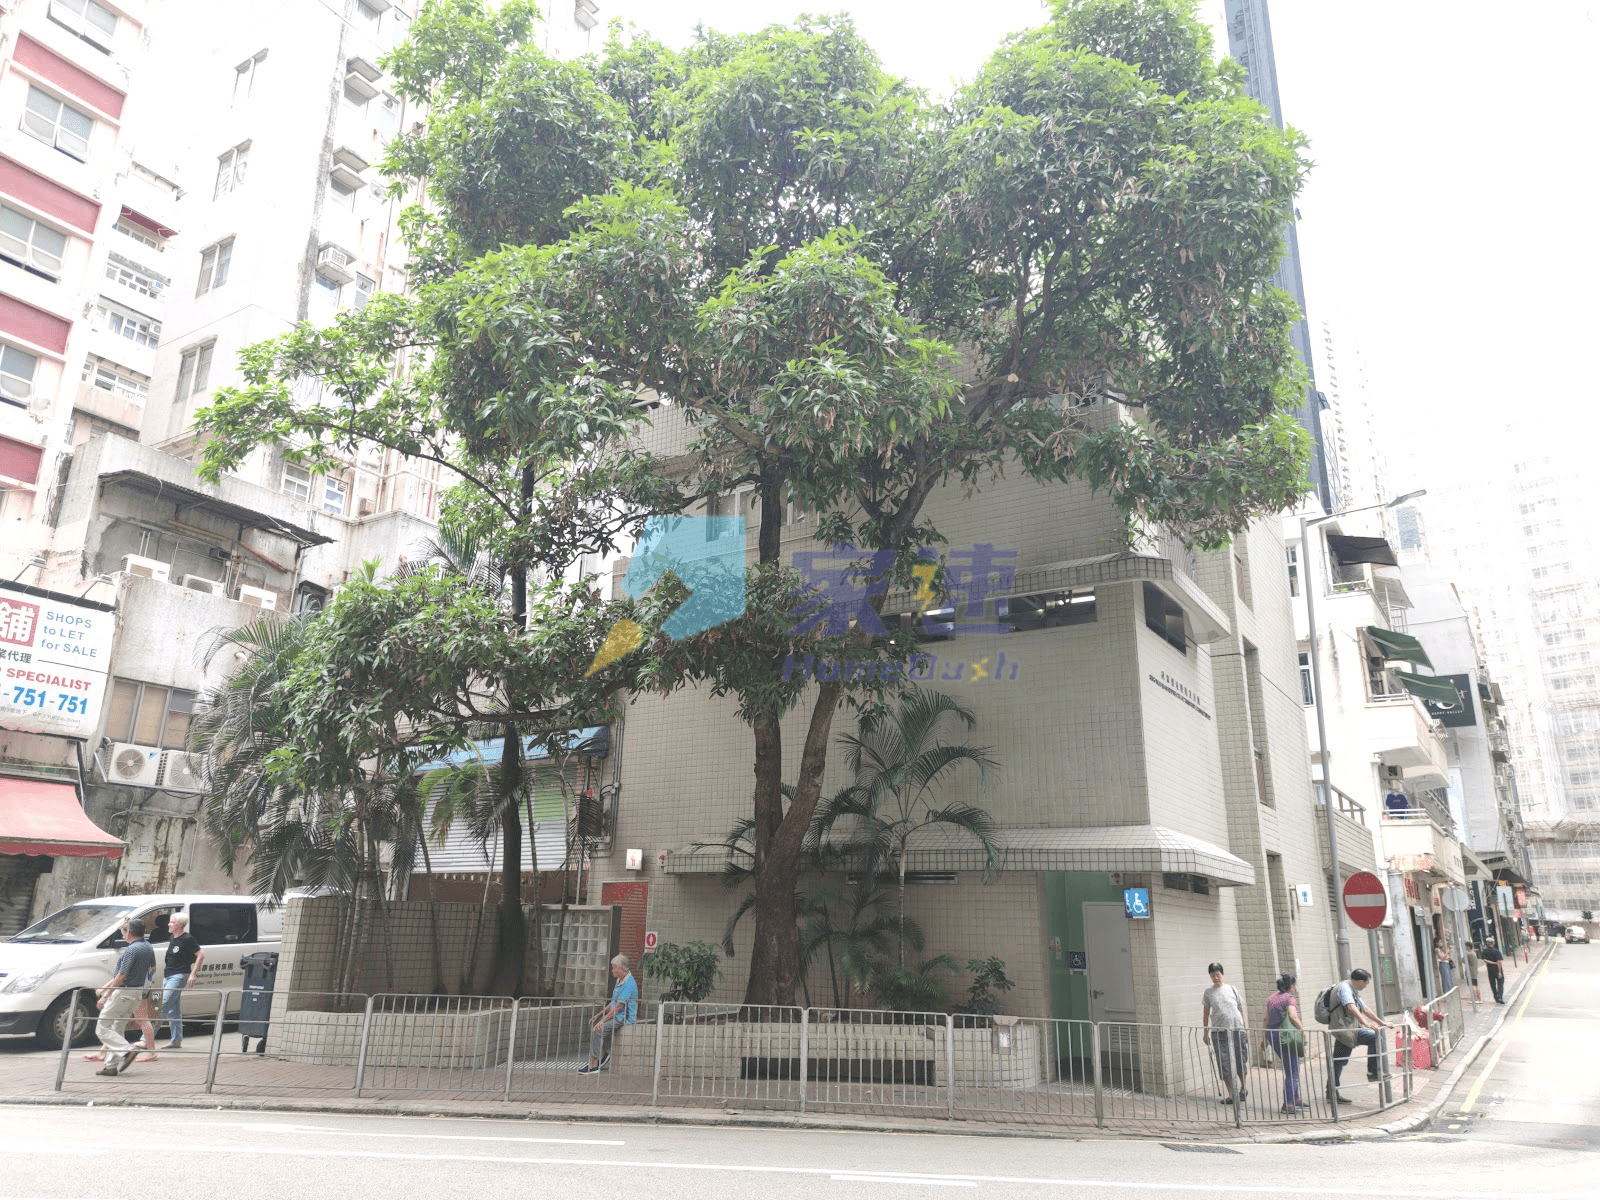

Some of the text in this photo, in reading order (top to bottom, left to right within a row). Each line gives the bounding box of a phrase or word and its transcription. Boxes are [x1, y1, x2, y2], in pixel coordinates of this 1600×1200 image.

[46, 611, 92, 628] SHOPS
[43, 626, 85, 641] to LET
[41, 638, 98, 658] for SALE
[6, 667, 92, 691] SPECIALIST
